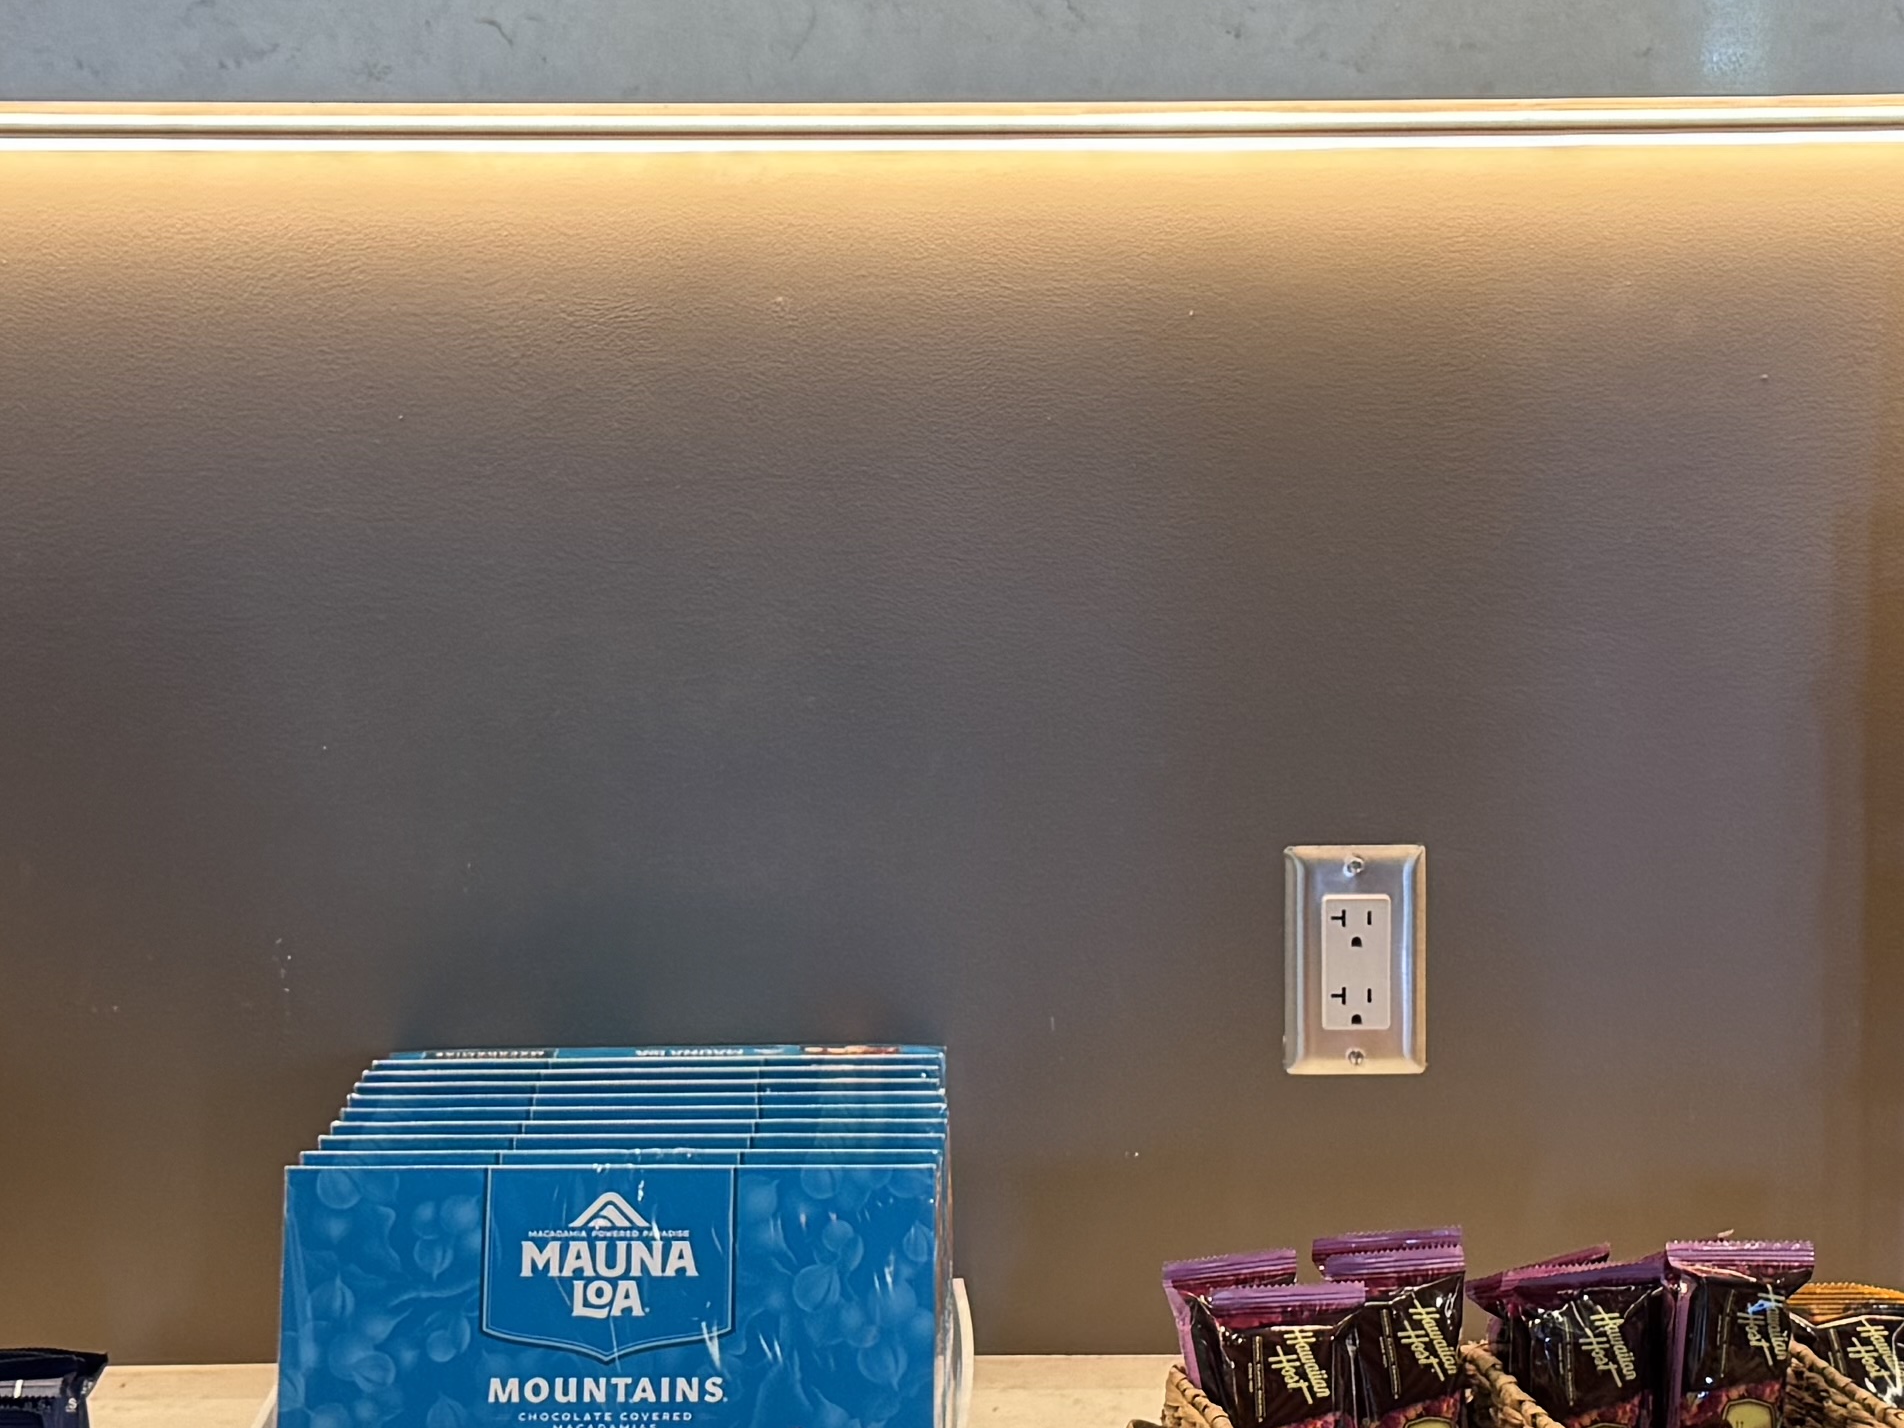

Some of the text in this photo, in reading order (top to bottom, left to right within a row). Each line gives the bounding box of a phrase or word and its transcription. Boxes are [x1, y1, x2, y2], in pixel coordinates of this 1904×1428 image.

[520, 1240, 699, 1278] MAUNA
[528, 1230, 639, 1238] MACADAMIA POWERED
[571, 1280, 646, 1319] LOA
[1284, 1329, 1330, 1398] Hawaiian
[1397, 1320, 1445, 1381] Host
[1409, 1298, 1457, 1375] Hawaiian
[1579, 1327, 1623, 1388] Host
[1590, 1304, 1637, 1381] Hawaiian
[1737, 1311, 1773, 1367] Host
[487, 1375, 726, 1405] MOUNTAINS
[1268, 1345, 1314, 1405] Host
[518, 1411, 692, 1422] CHOCOLATE COVERED
